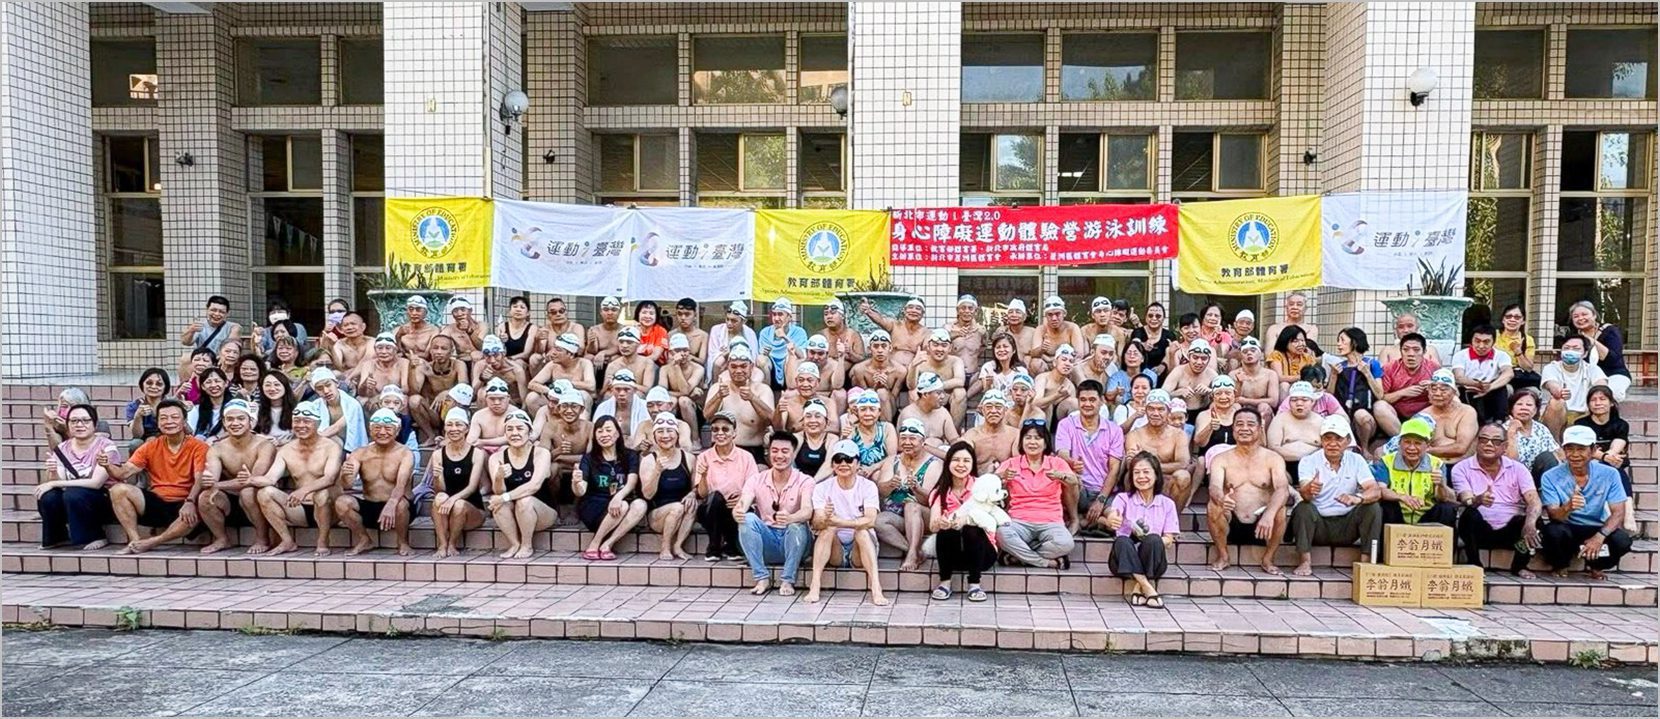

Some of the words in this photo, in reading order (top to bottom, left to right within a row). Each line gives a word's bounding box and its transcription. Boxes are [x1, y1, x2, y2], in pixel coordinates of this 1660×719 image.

[892, 214, 1169, 243] 身心障礙運動體驗營游泳訓練
[1221, 264, 1289, 278] 教育部體育署
[599, 475, 609, 487] R
[1397, 538, 1444, 551] 李翁月娥
